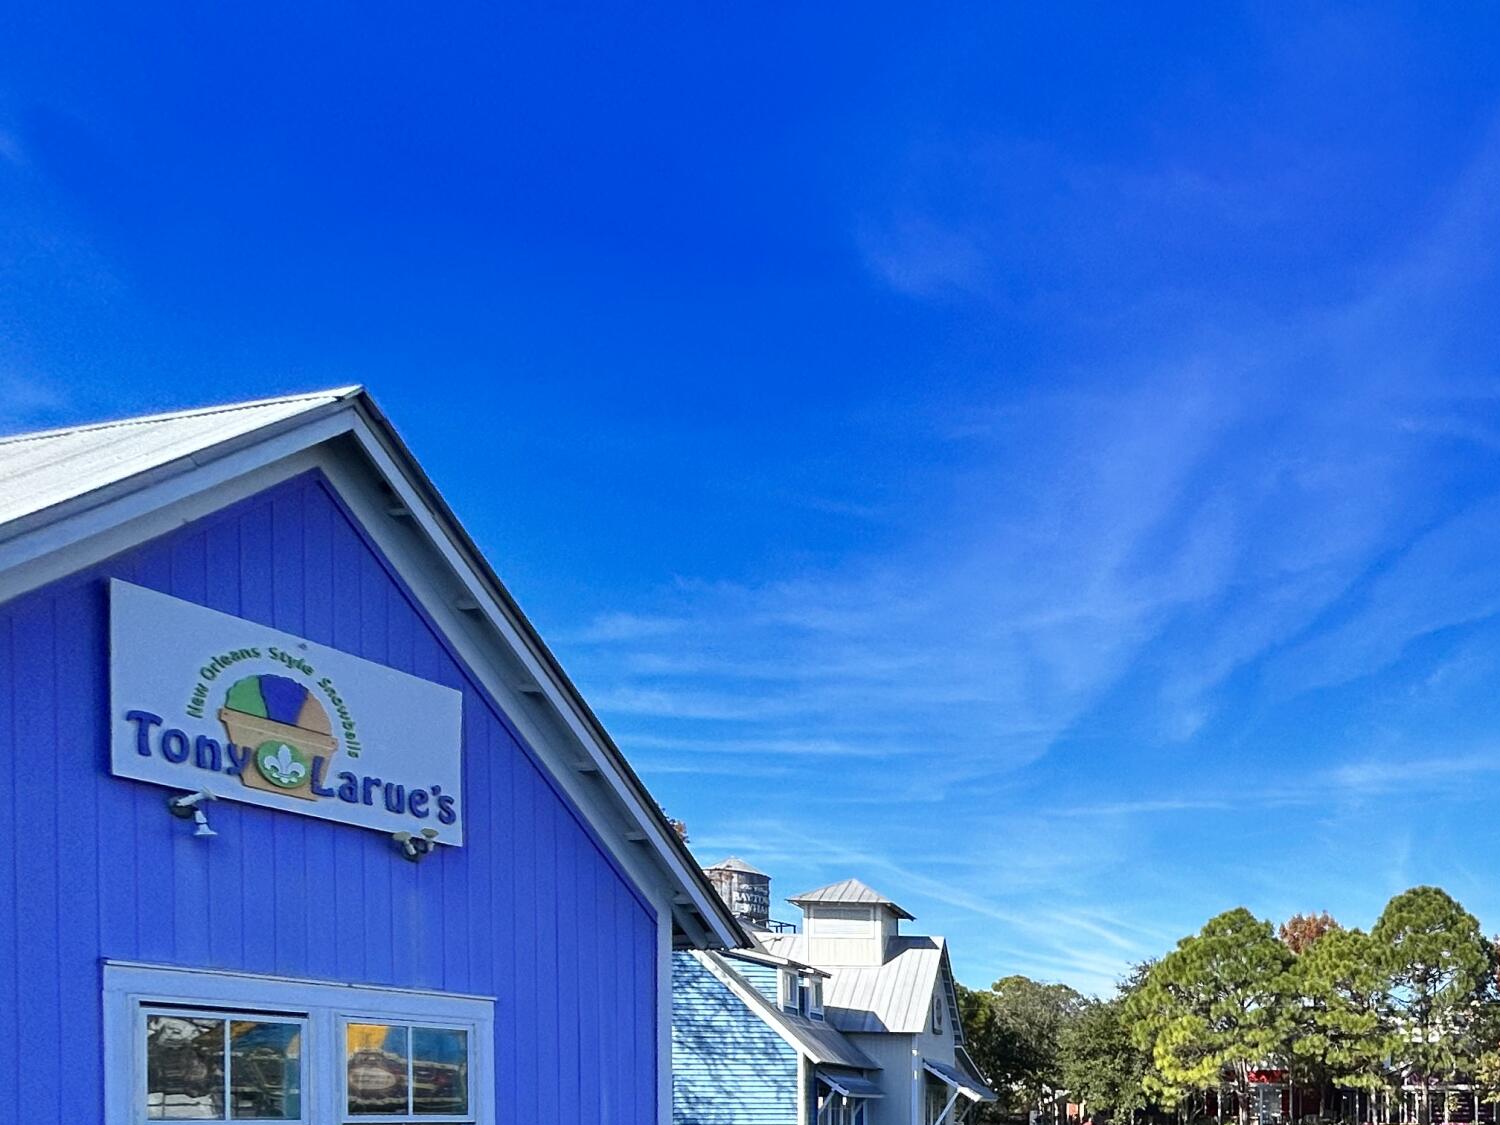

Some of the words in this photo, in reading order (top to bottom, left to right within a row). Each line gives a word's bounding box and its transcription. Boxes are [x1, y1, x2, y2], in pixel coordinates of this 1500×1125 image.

[186, 682, 209, 719] New
[200, 648, 261, 681] Orleans
[268, 647, 315, 676] Style
[317, 677, 361, 758] Snowballs
[126, 709, 252, 776] Tony
[311, 755, 456, 825] Larue's
